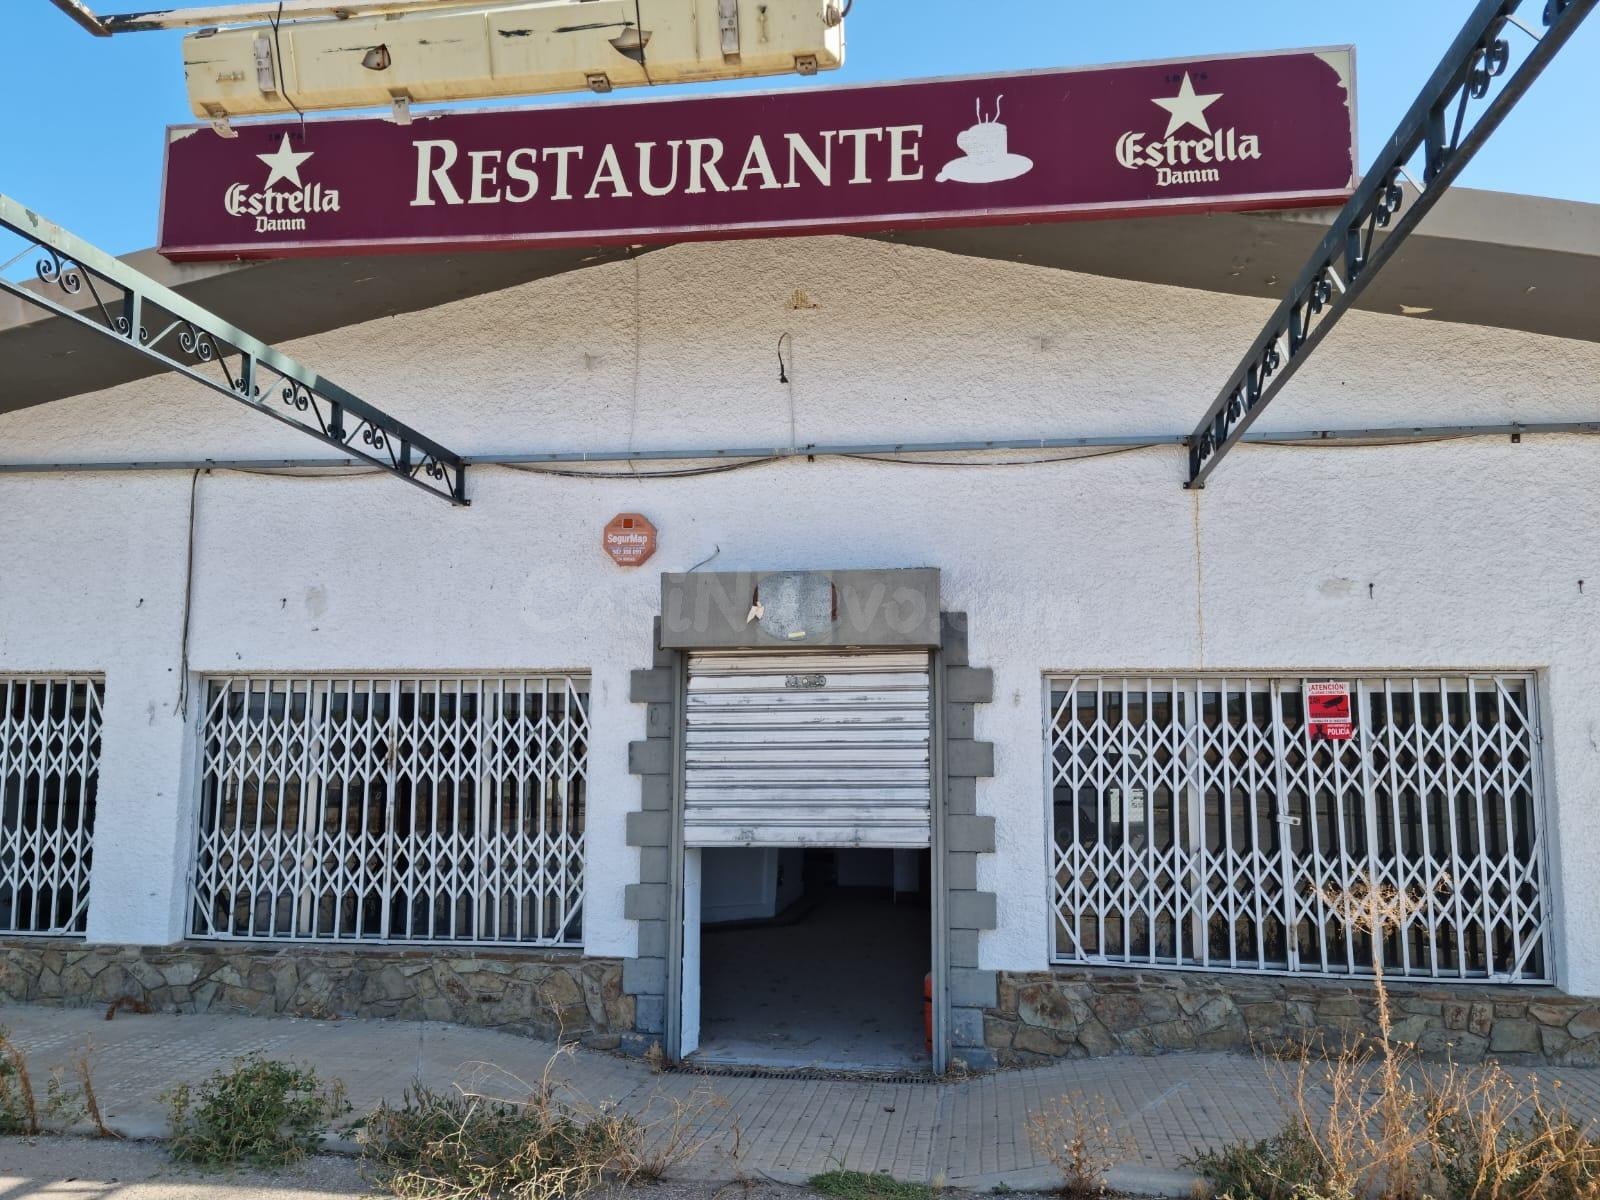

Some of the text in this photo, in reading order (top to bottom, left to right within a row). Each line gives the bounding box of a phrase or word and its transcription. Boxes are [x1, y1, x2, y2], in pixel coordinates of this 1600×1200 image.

[409, 123, 925, 207] RESTAURANTE
[1115, 126, 1262, 170] Estrella
[1155, 167, 1221, 188] Damm
[224, 181, 341, 217] Estrella
[254, 215, 306, 233] Damm
